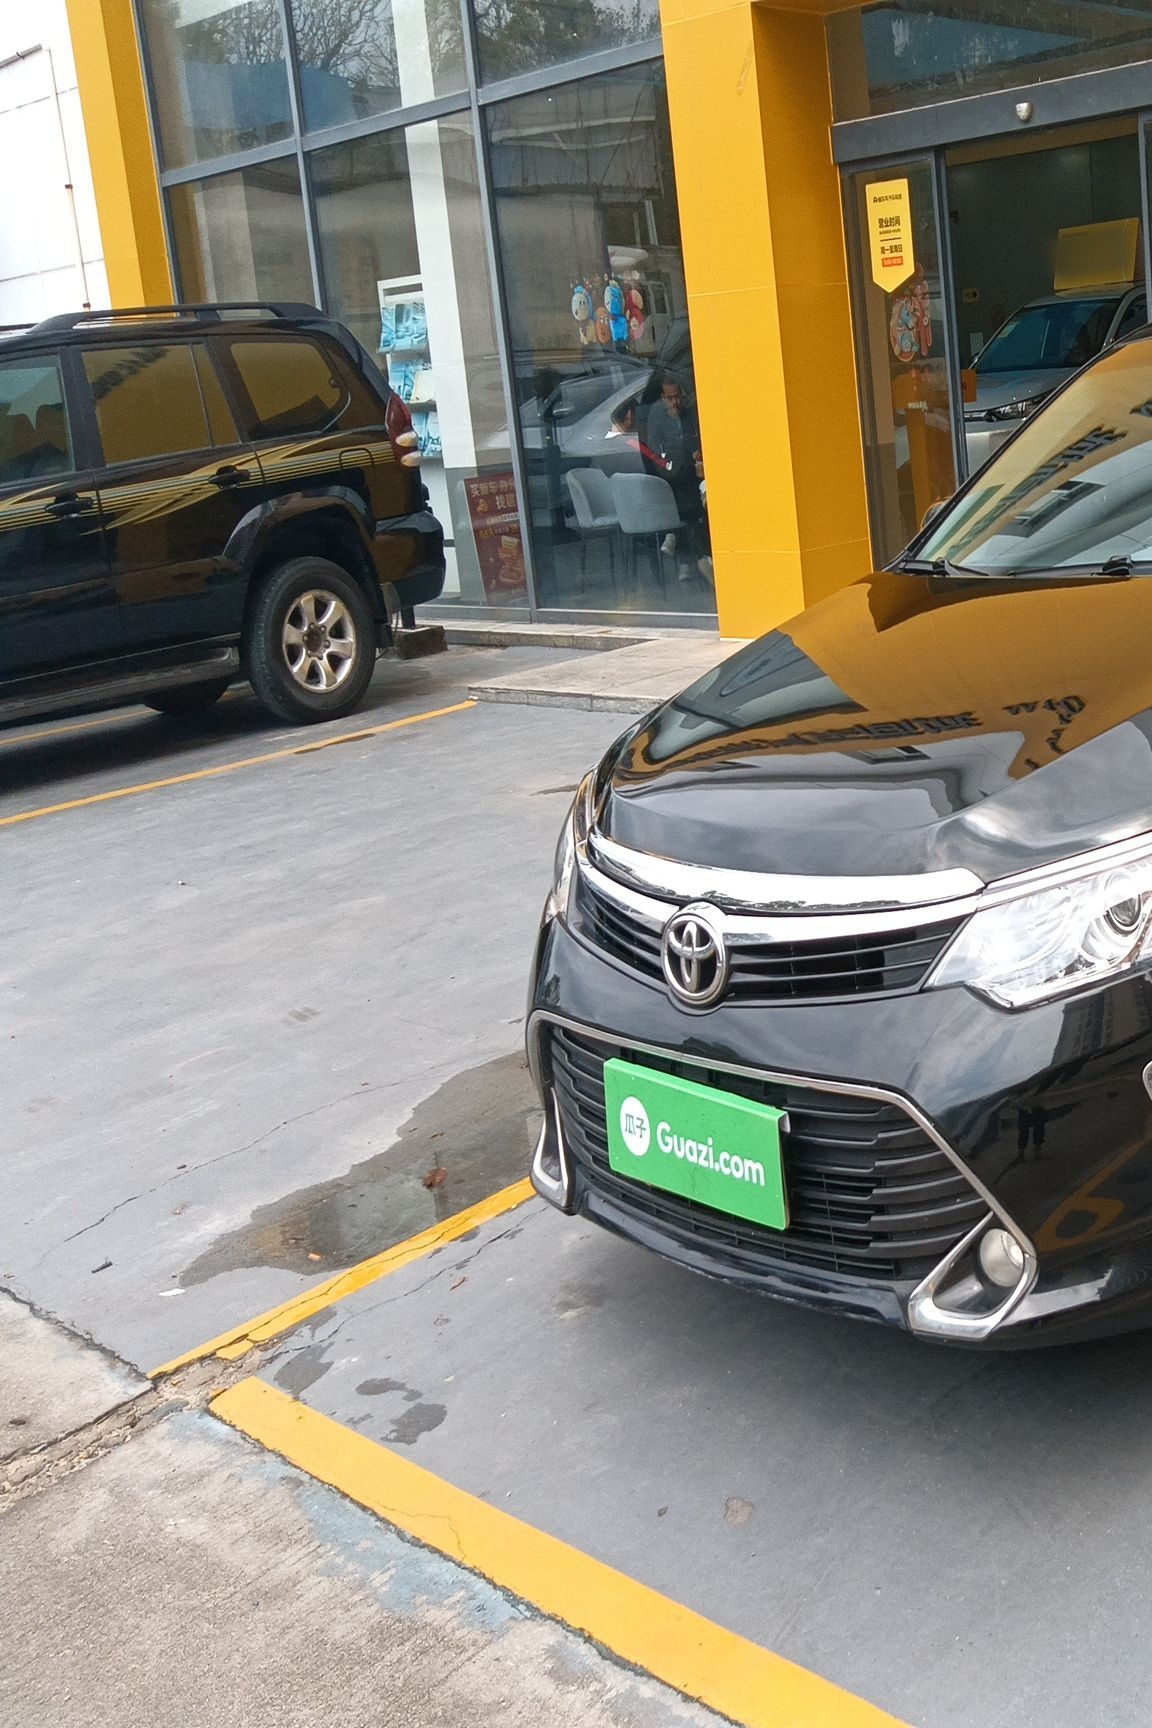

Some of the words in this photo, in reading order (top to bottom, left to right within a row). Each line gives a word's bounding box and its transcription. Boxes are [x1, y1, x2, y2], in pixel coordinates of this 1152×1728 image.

[878, 215, 901, 229] 营业时间
[880, 244, 903, 255] 周一至周日
[470, 481, 498, 497] 买新车
[625, 1113, 647, 1139] 瓜子
[656, 1121, 766, 1187] Guazi.com
